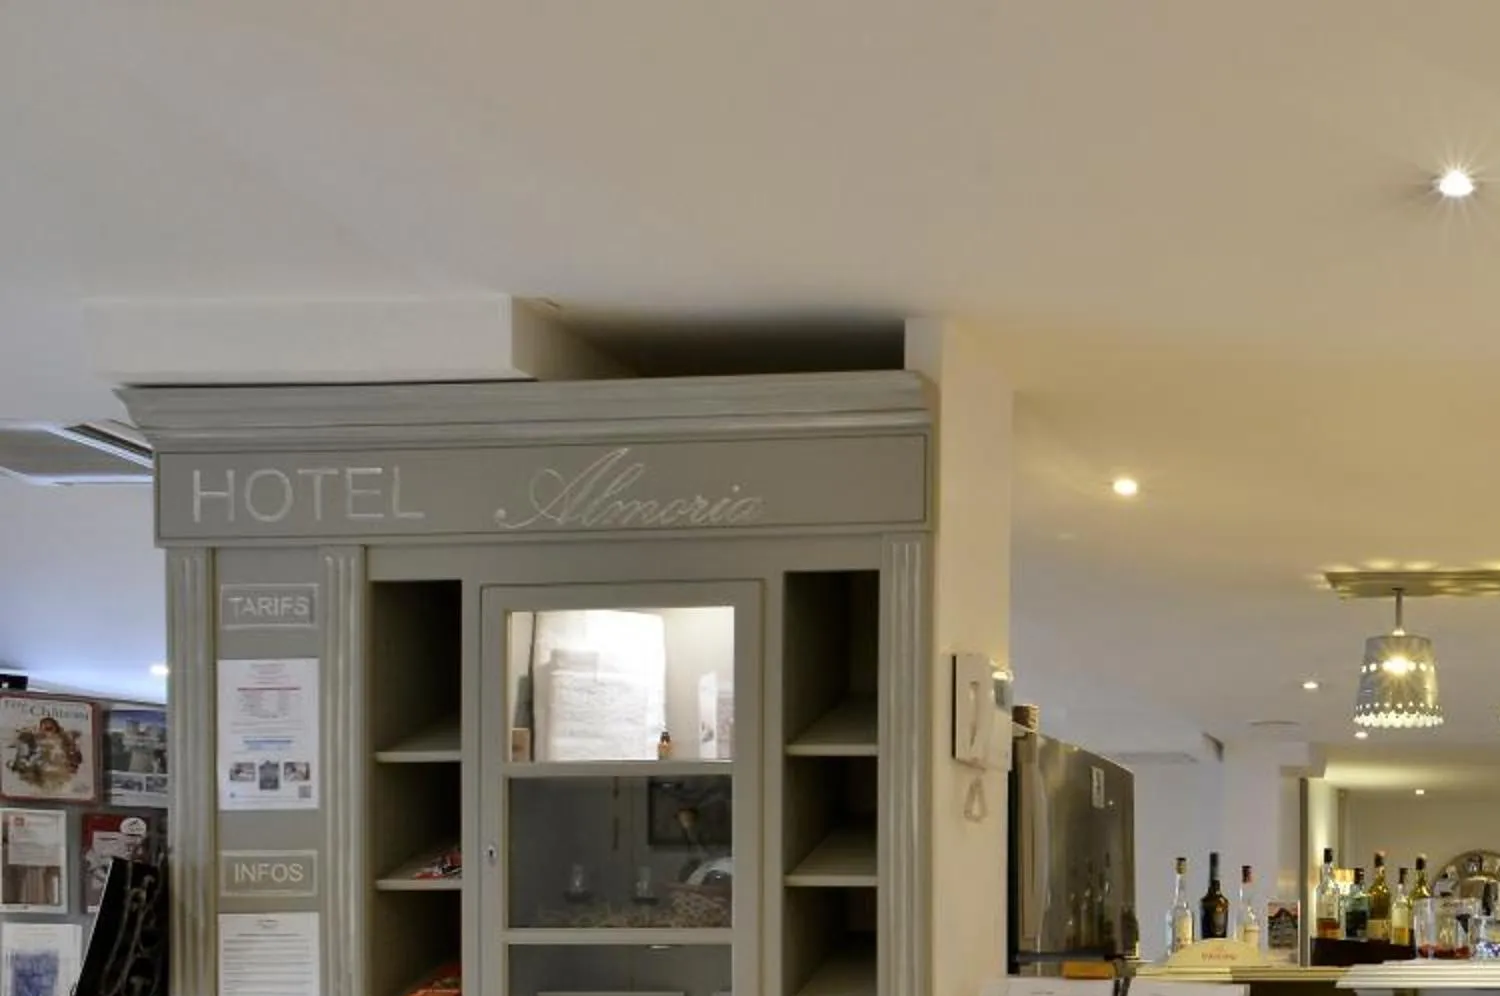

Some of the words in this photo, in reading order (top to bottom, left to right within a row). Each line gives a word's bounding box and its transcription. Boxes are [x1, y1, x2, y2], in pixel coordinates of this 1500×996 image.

[192, 465, 426, 524] HOTEL
[493, 446, 767, 530] Almoria
[227, 595, 311, 618] TARIFS
[234, 862, 304, 884] INFOS
